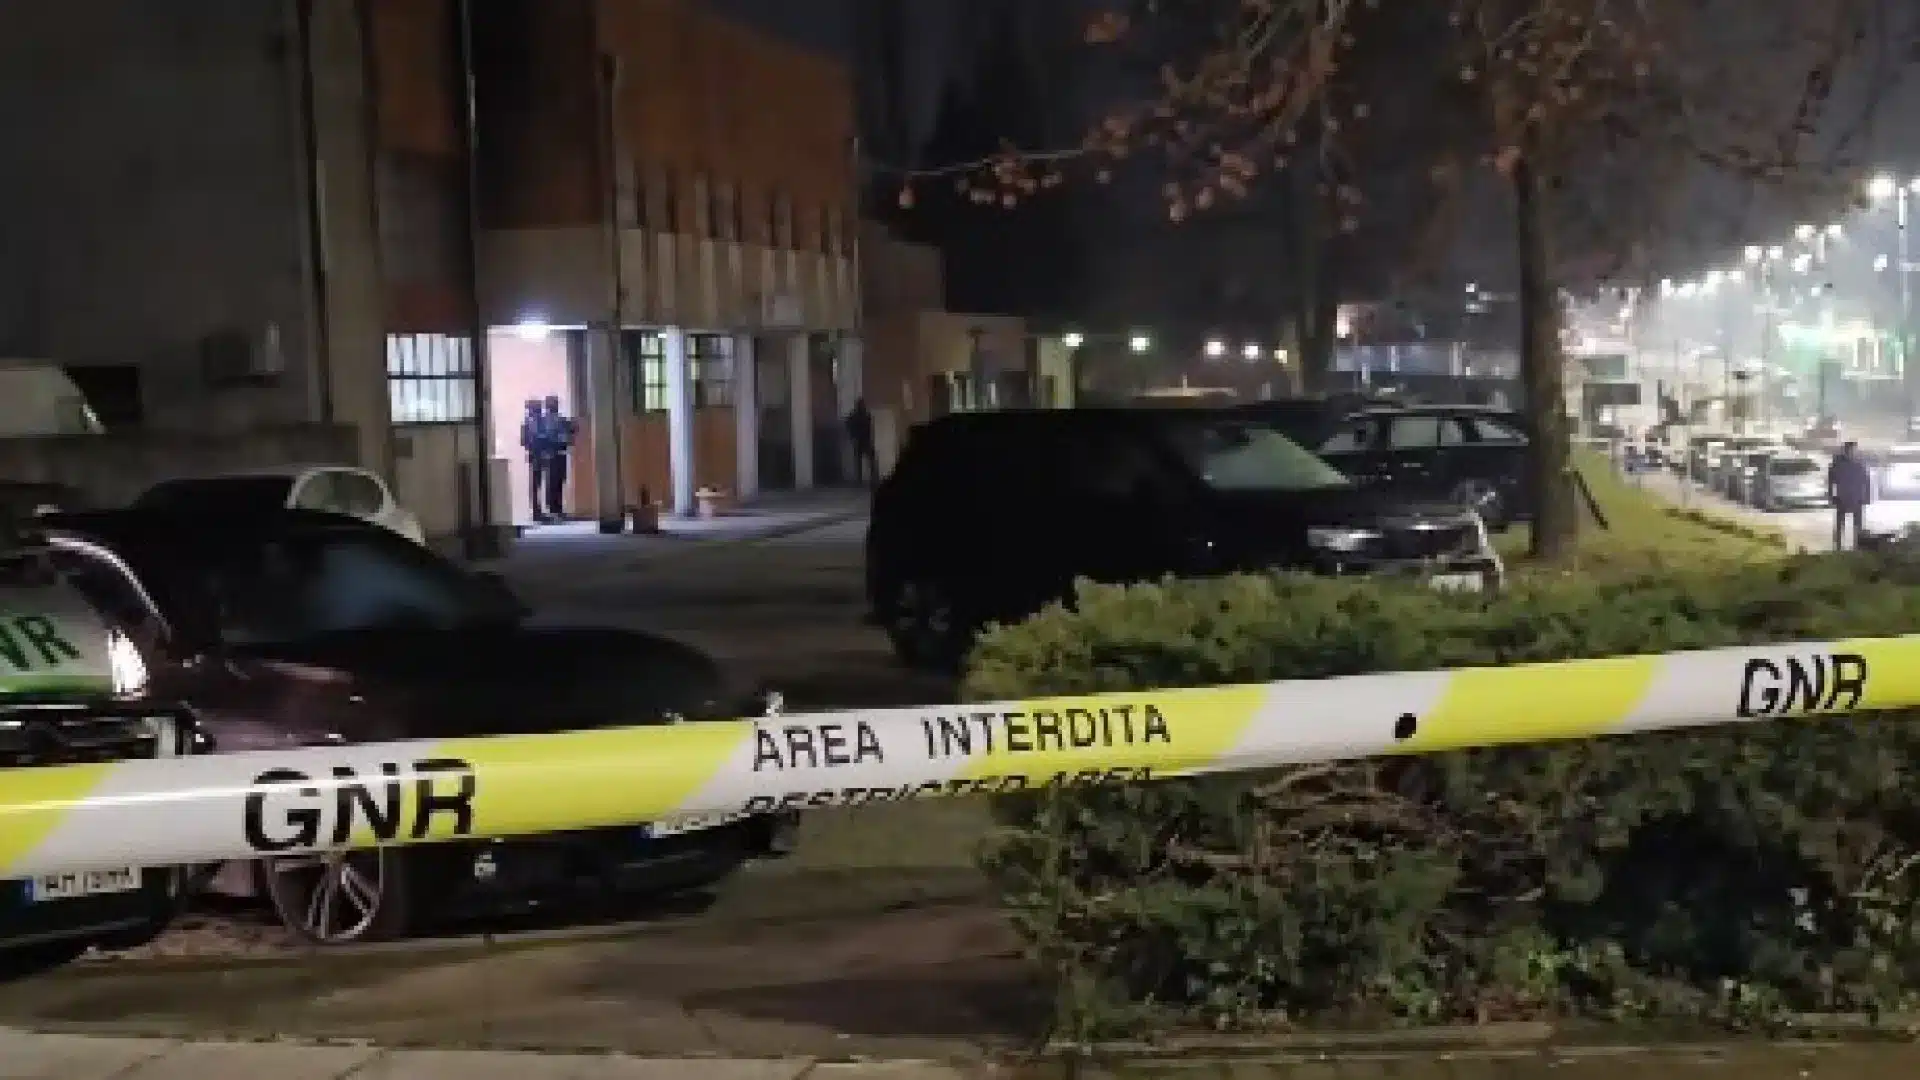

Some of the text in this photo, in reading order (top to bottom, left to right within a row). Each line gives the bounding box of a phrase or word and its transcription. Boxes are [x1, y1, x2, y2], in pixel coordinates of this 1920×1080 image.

[1737, 653, 1867, 717] GNR
[921, 704, 1171, 760] INTERDITA
[245, 758, 475, 851] GNR
